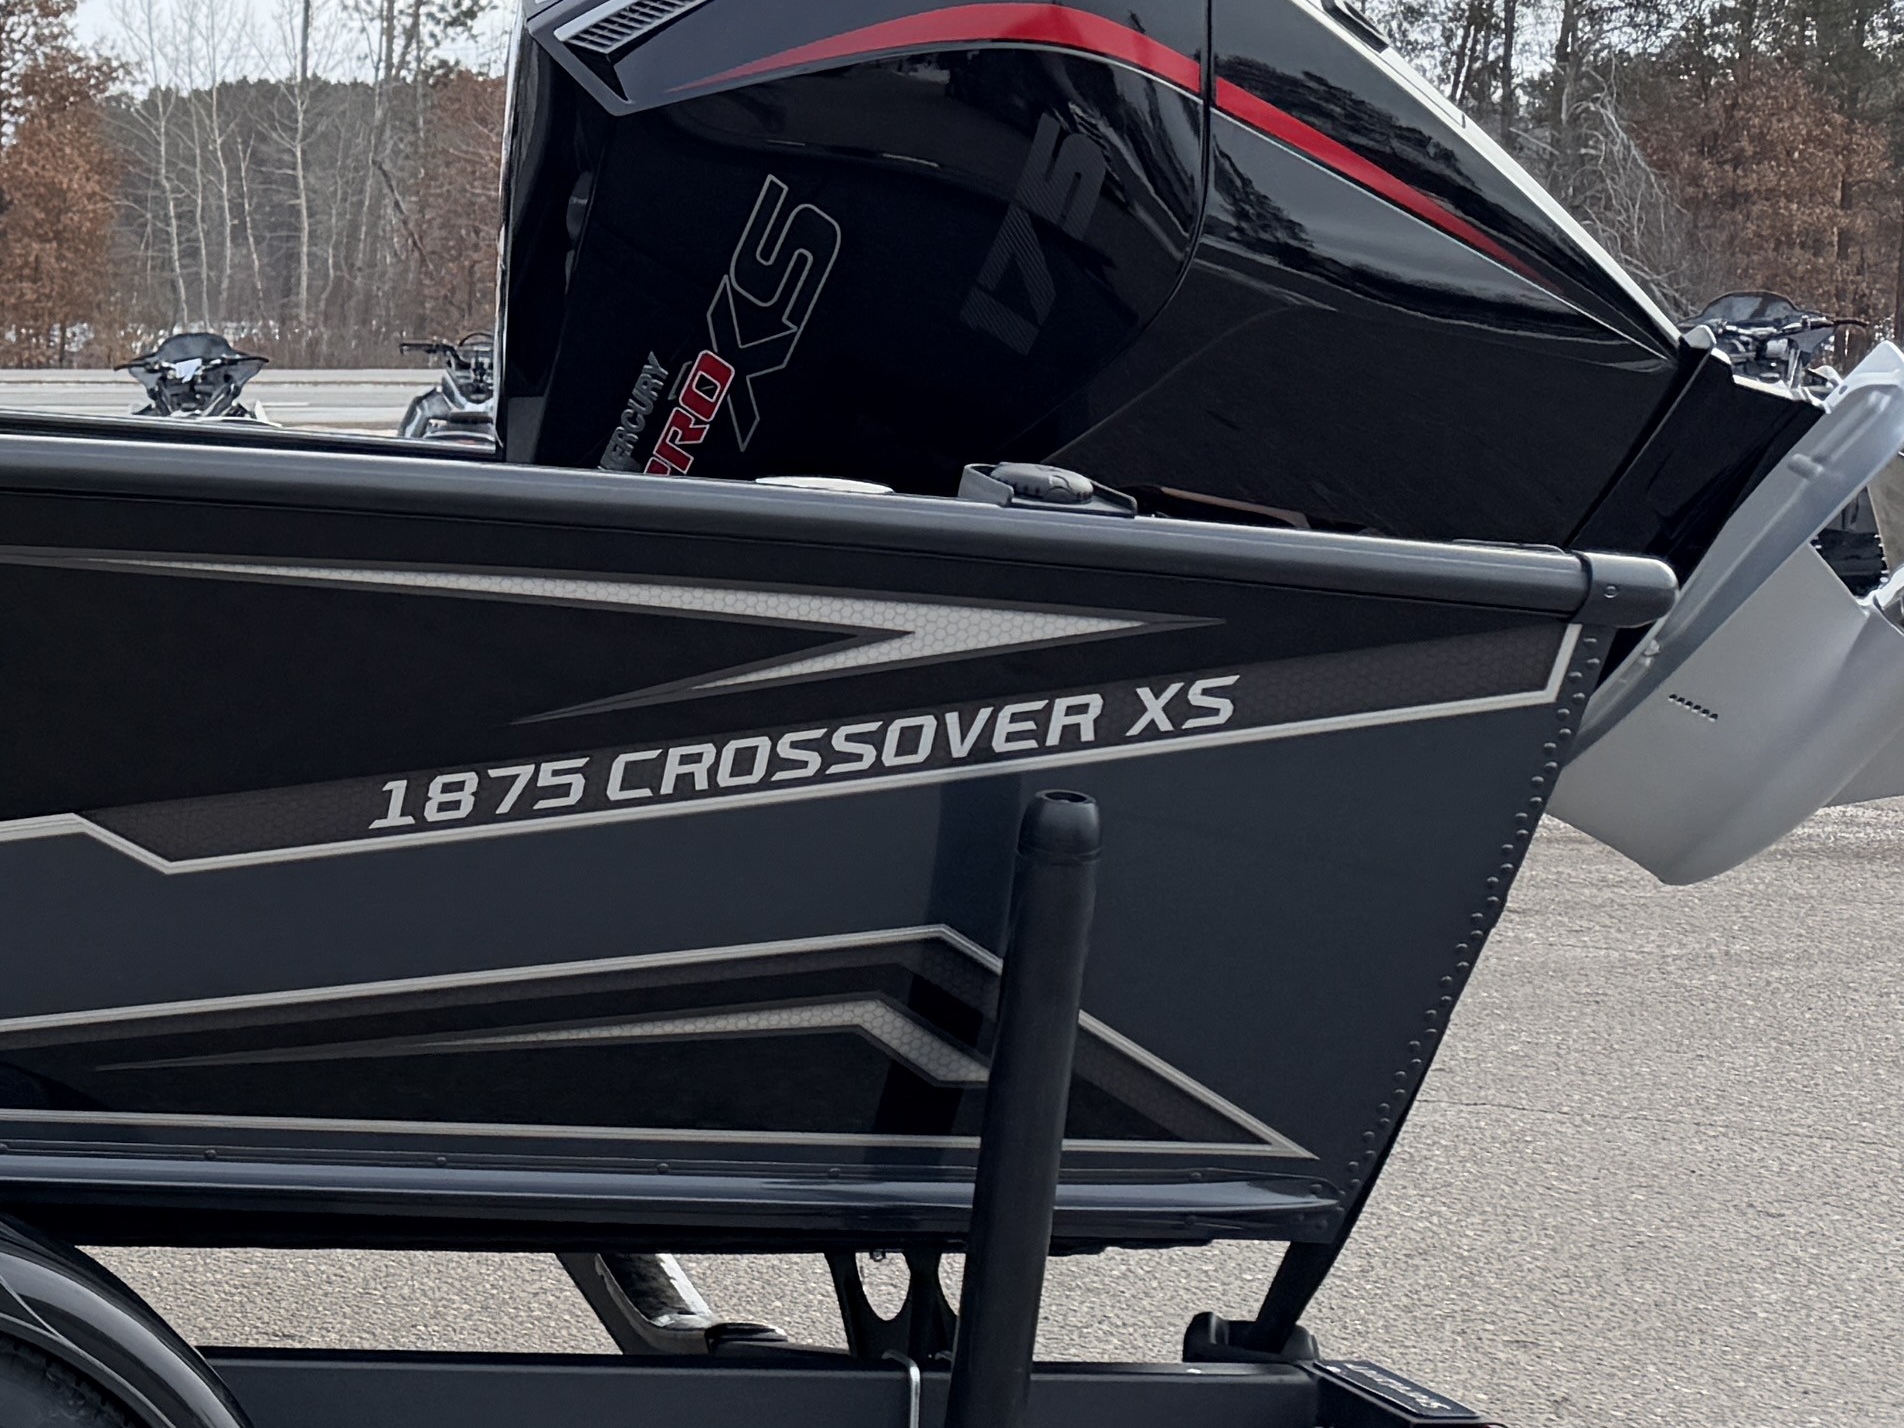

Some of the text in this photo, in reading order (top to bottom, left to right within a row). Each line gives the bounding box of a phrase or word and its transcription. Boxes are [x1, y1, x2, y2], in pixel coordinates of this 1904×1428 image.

[597, 351, 668, 471] ERCURY
[368, 675, 1240, 829] 1875 CROSSOVER XS
